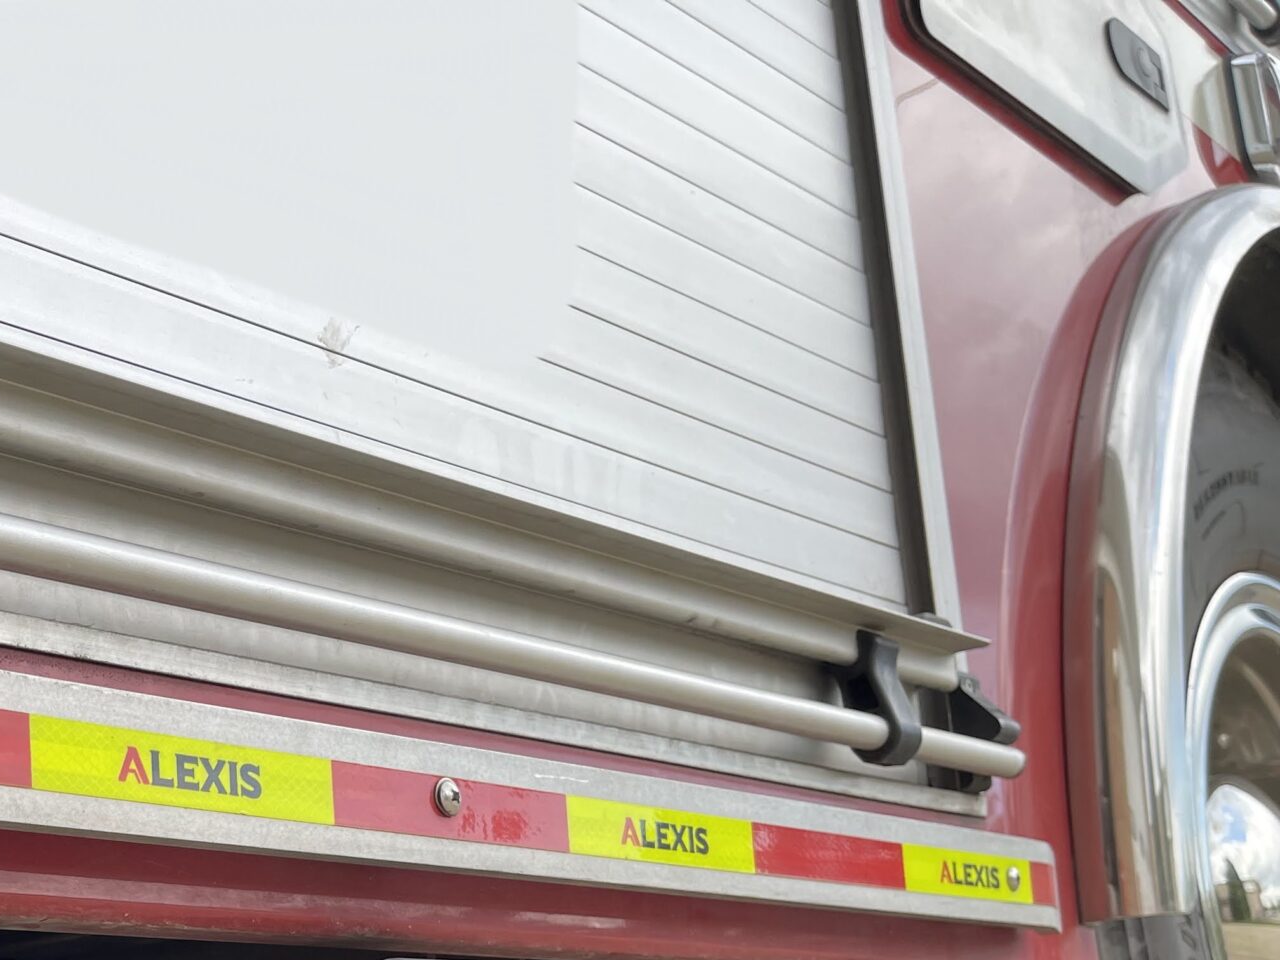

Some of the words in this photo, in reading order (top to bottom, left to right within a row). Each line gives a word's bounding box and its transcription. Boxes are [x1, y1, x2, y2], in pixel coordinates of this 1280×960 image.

[118, 745, 262, 799] ALEXIS
[621, 816, 709, 855] ALEXIS
[940, 860, 1000, 889] ALEXIS
